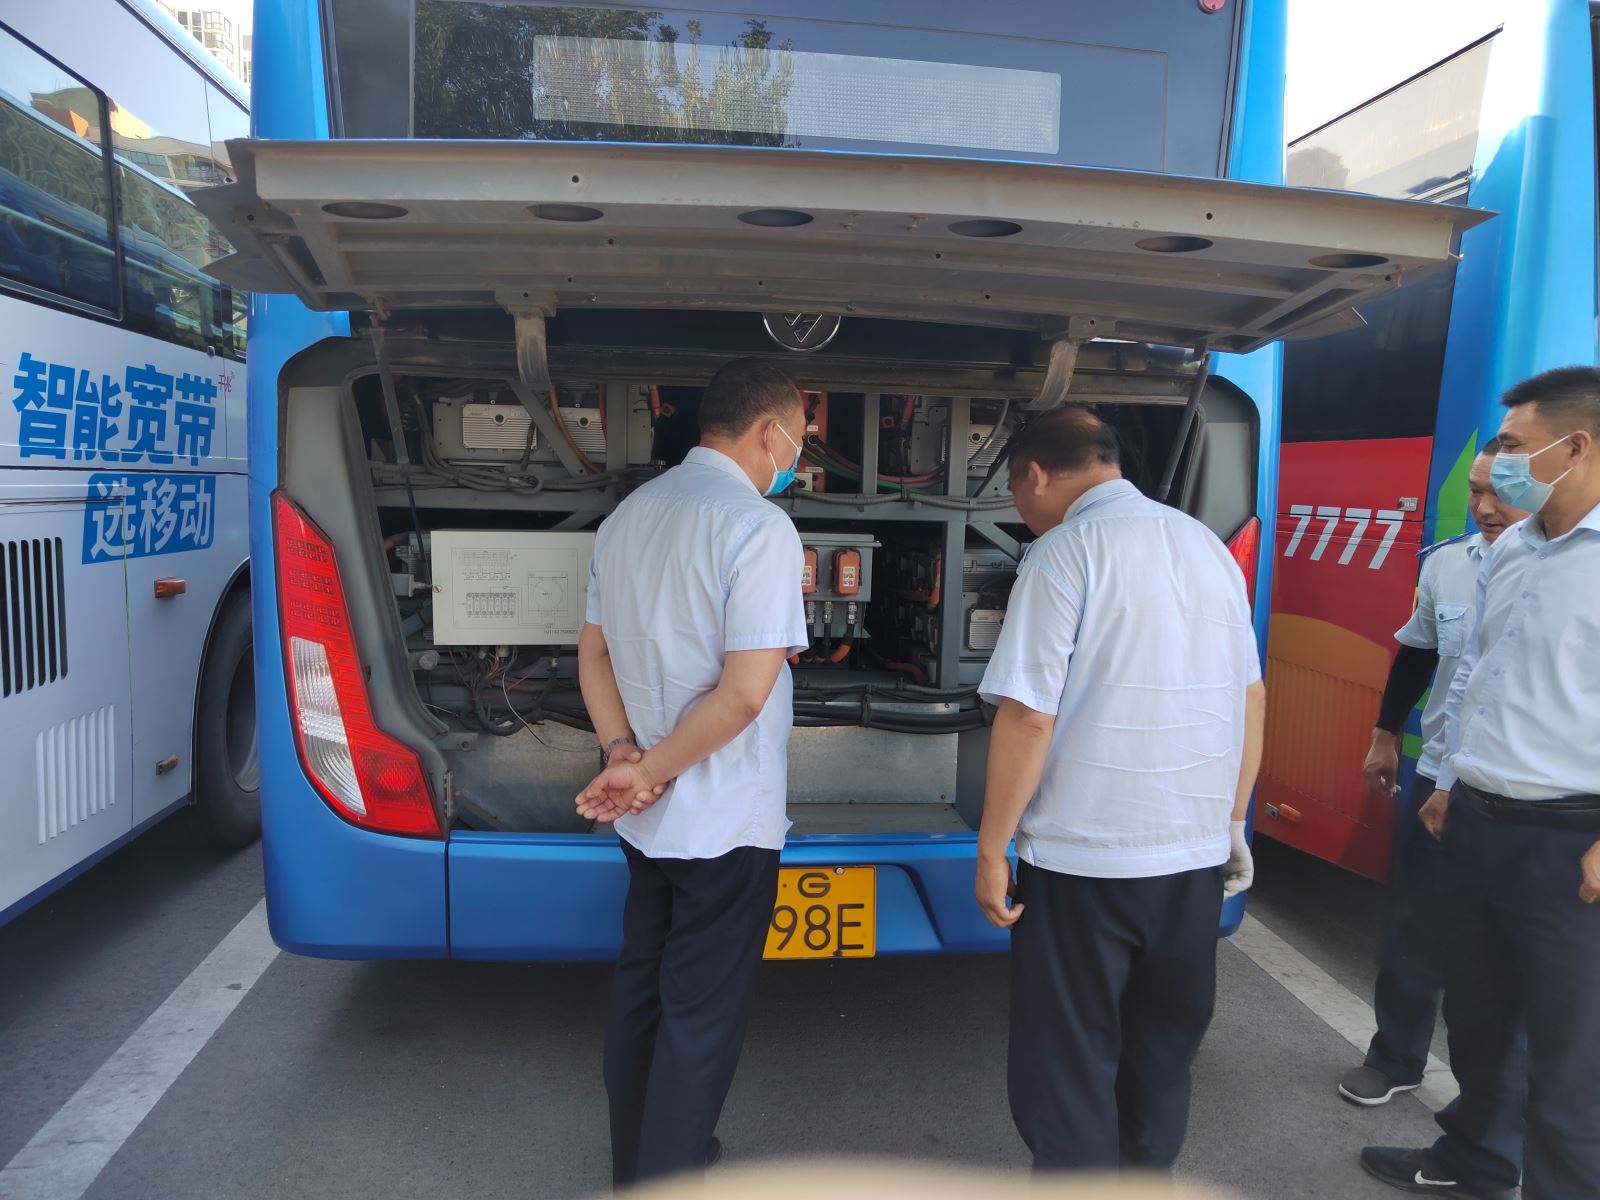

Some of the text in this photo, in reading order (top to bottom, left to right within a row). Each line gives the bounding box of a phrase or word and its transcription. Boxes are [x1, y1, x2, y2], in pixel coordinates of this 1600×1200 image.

[12, 351, 218, 466] 智能宽带
[90, 477, 212, 560] 选移动
[1283, 504, 1405, 570] 7777
